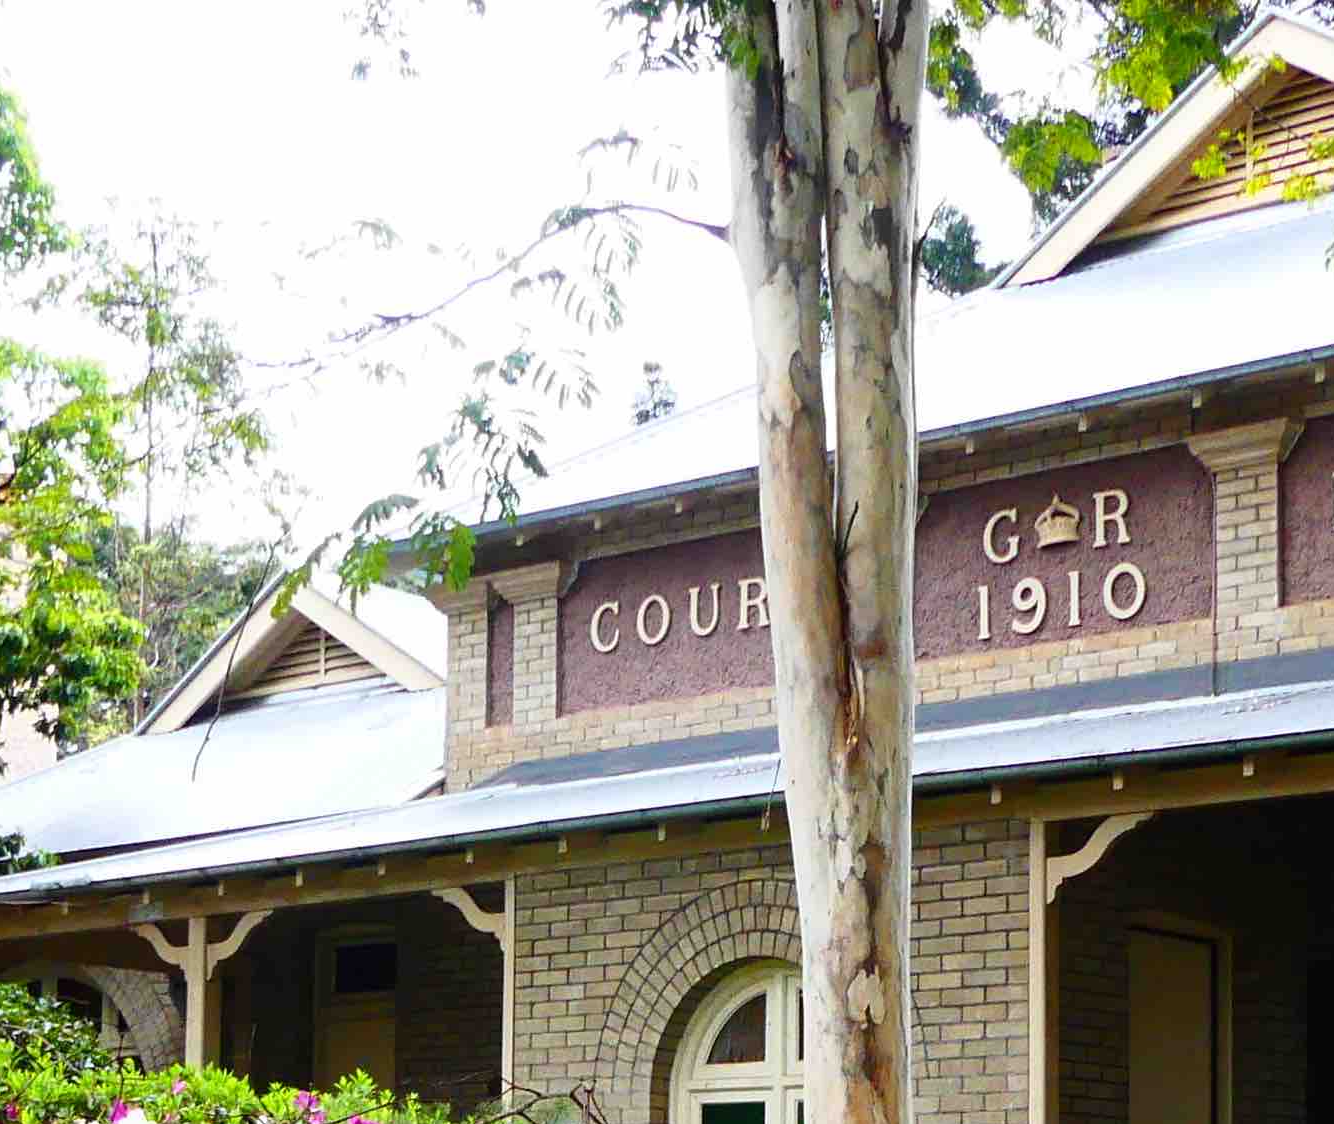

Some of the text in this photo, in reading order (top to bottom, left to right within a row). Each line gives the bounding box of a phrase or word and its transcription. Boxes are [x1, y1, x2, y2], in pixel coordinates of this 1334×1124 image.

[983, 489, 1131, 565] G R
[589, 577, 771, 654] COUR
[977, 562, 1147, 641] 1910
